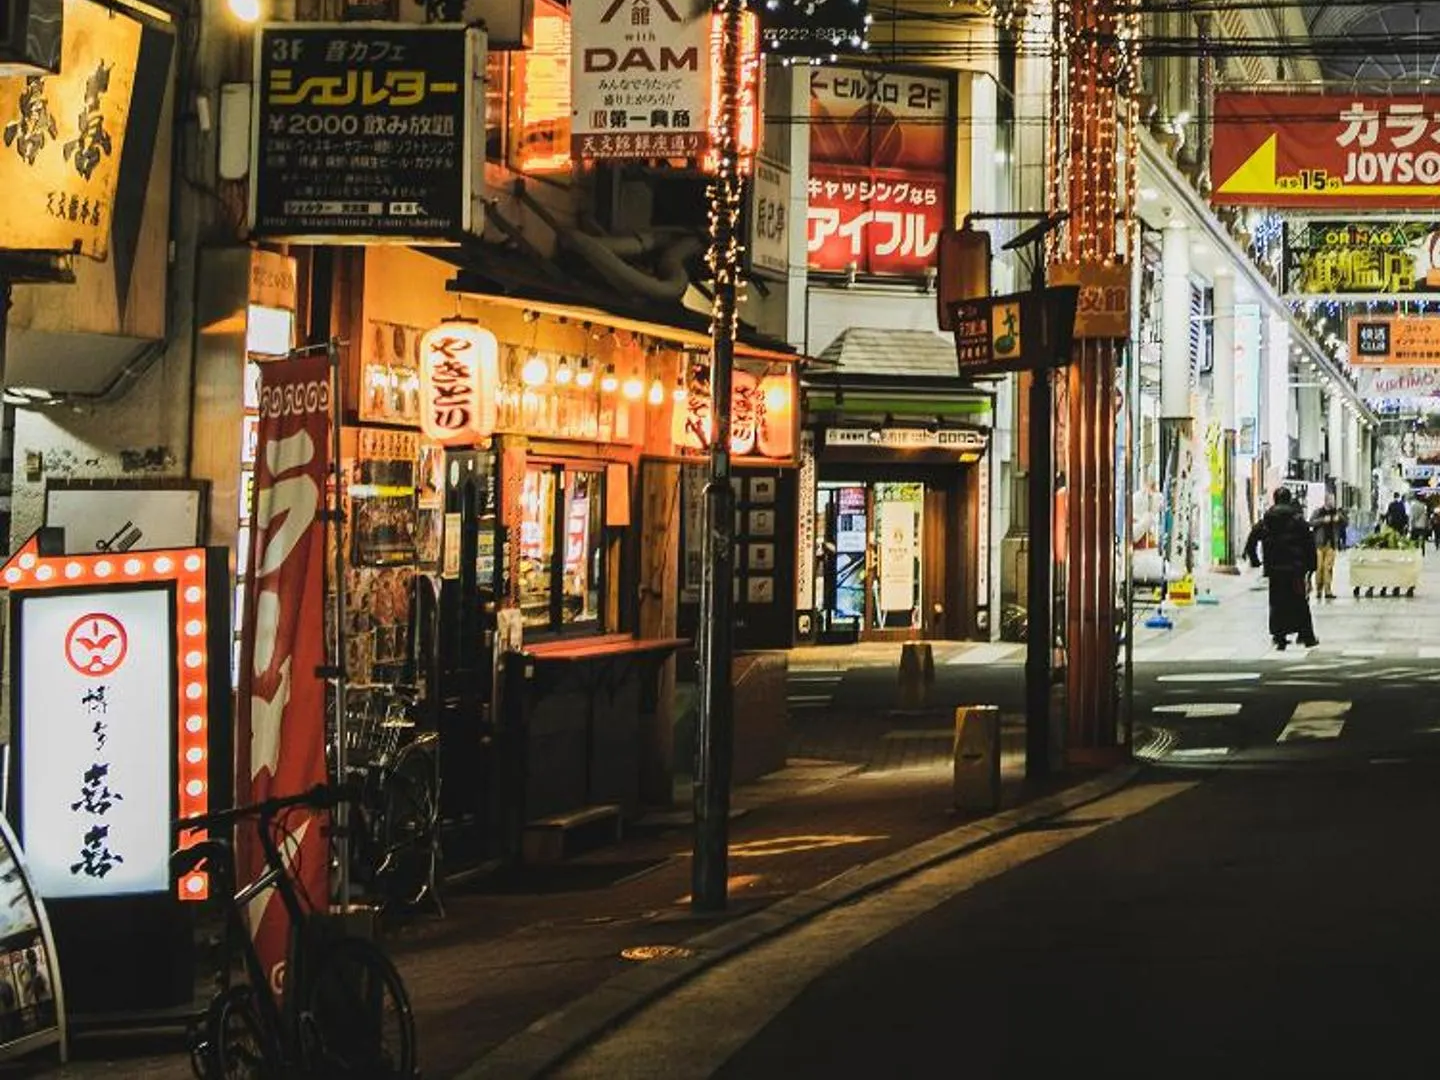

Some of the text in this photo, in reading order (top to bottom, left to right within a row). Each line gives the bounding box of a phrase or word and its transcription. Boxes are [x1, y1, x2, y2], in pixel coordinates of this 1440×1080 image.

[272, 39, 407, 62] 3F 音カフェ
[624, 32, 656, 42] with
[583, 46, 698, 73] DAM
[268, 70, 459, 106] シェルター
[907, 82, 942, 109] 2F
[362, 113, 456, 137] 飲み放題
[807, 178, 938, 206] キャッシングなら
[807, 206, 938, 258] アイフル
